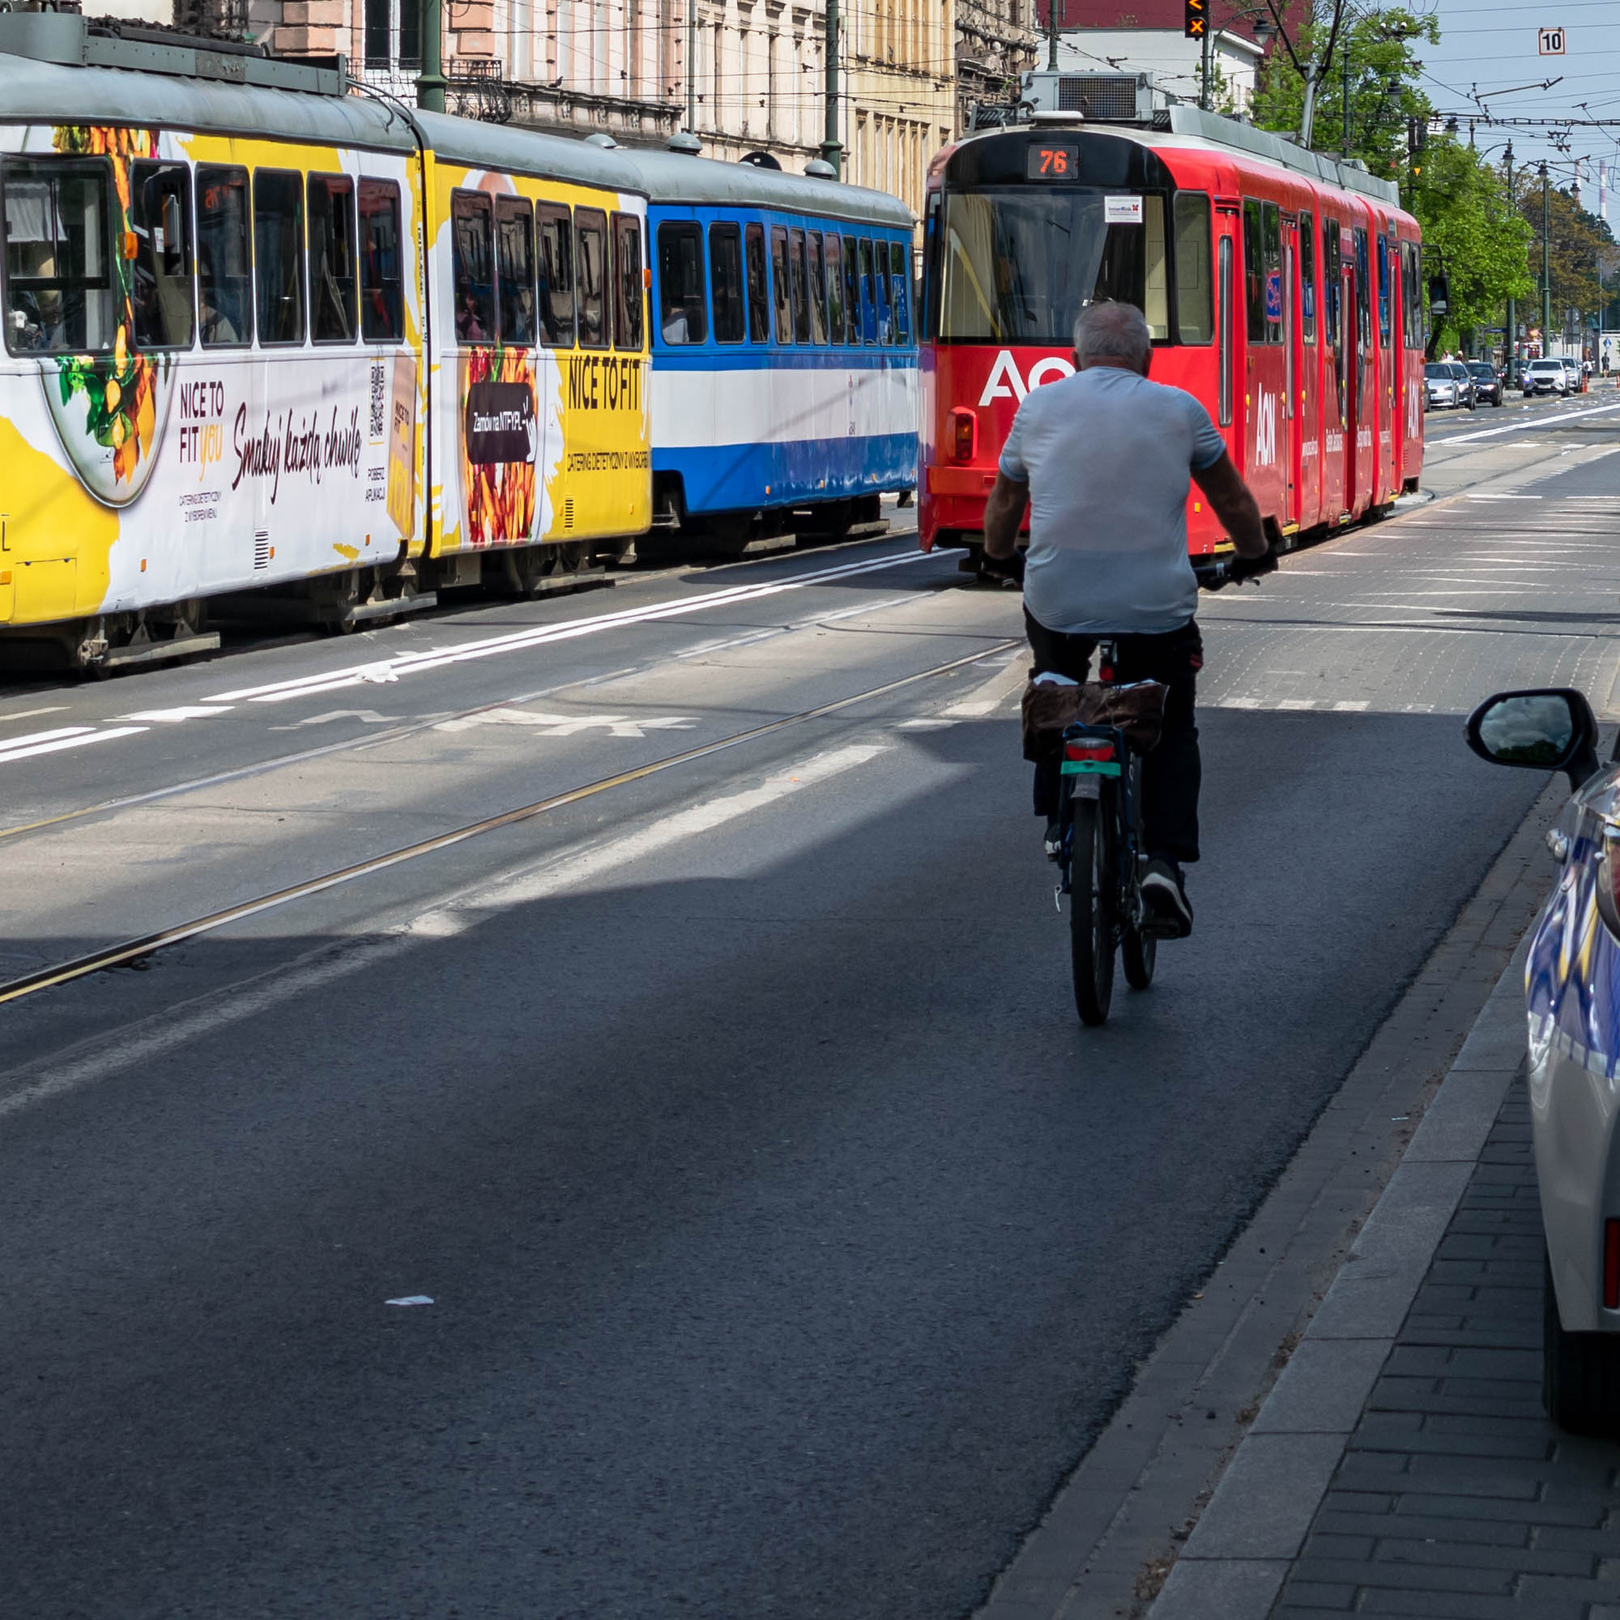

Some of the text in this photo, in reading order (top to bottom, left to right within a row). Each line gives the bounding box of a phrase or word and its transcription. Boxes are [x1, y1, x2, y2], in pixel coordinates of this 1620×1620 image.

[1542, 33, 1562, 51] 10
[1039, 150, 1068, 174] 76
[180, 380, 224, 420] NICE TO
[568, 355, 598, 411] NICE
[602, 355, 618, 411] TO
[620, 356, 640, 411] FIT
[1255, 382, 1276, 467] AON
[180, 426, 199, 464] FIT
[232, 401, 281, 505] Smakuj
